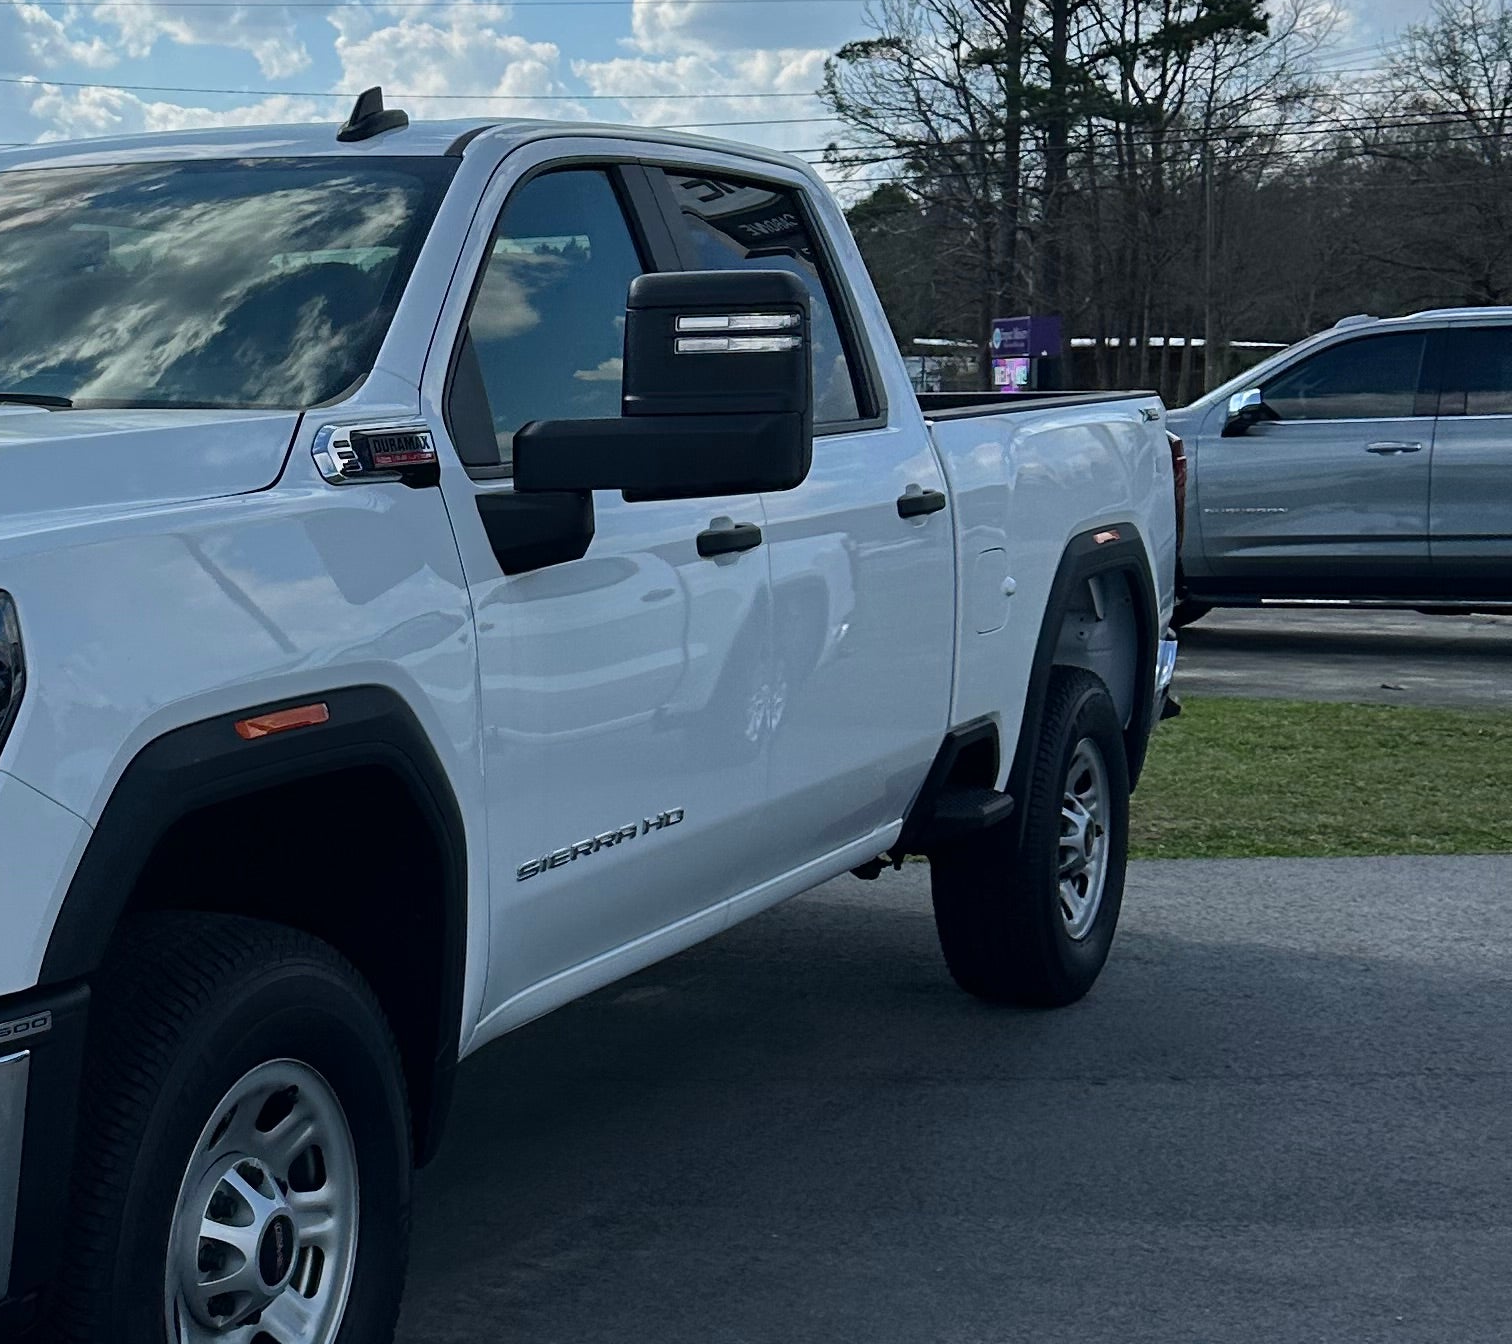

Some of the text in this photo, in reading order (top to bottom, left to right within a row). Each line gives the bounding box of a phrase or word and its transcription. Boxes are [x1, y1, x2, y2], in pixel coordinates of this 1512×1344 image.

[373, 436, 431, 453] DURAMAX
[516, 807, 684, 881] SIERRA HD
